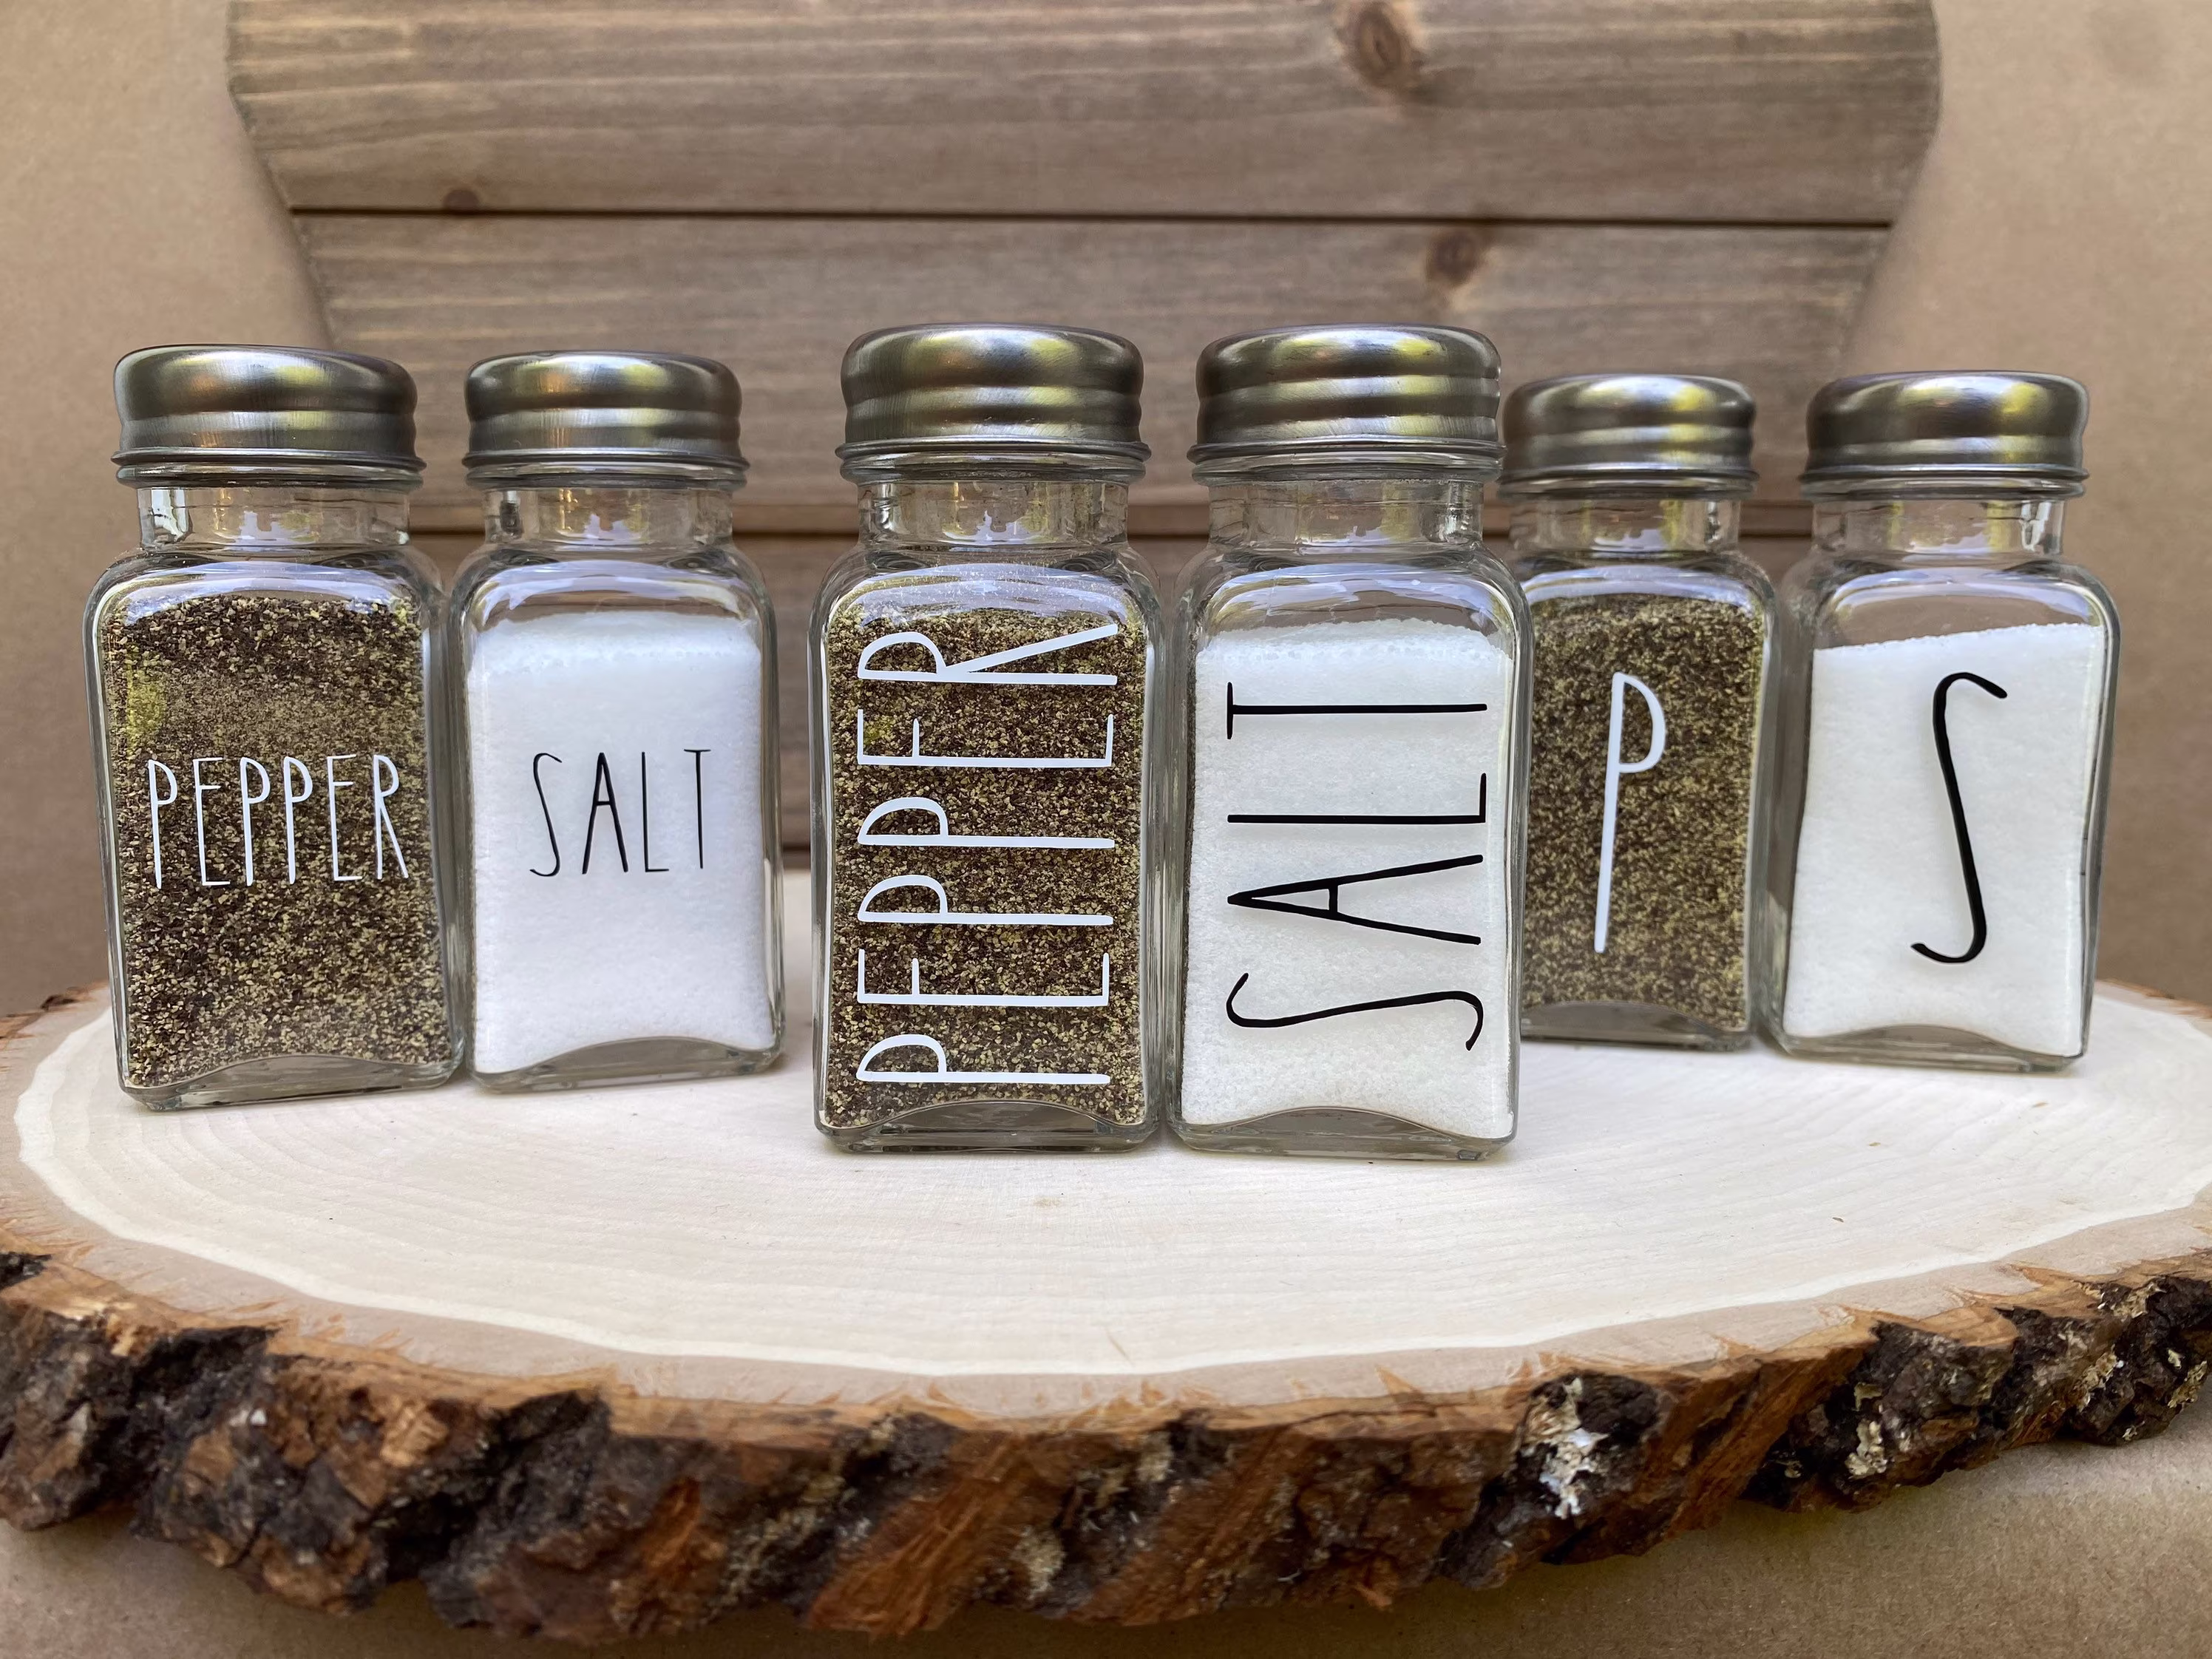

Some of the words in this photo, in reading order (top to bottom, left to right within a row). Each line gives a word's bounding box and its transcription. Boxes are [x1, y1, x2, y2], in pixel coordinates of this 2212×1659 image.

[148, 753, 409, 888] PEPPER
[529, 748, 712, 878] SALT
[858, 624, 1119, 1085] PEPPER
[1227, 682, 1487, 1051] SALT
[1594, 671, 1666, 952] P
[1910, 671, 2008, 963] S
